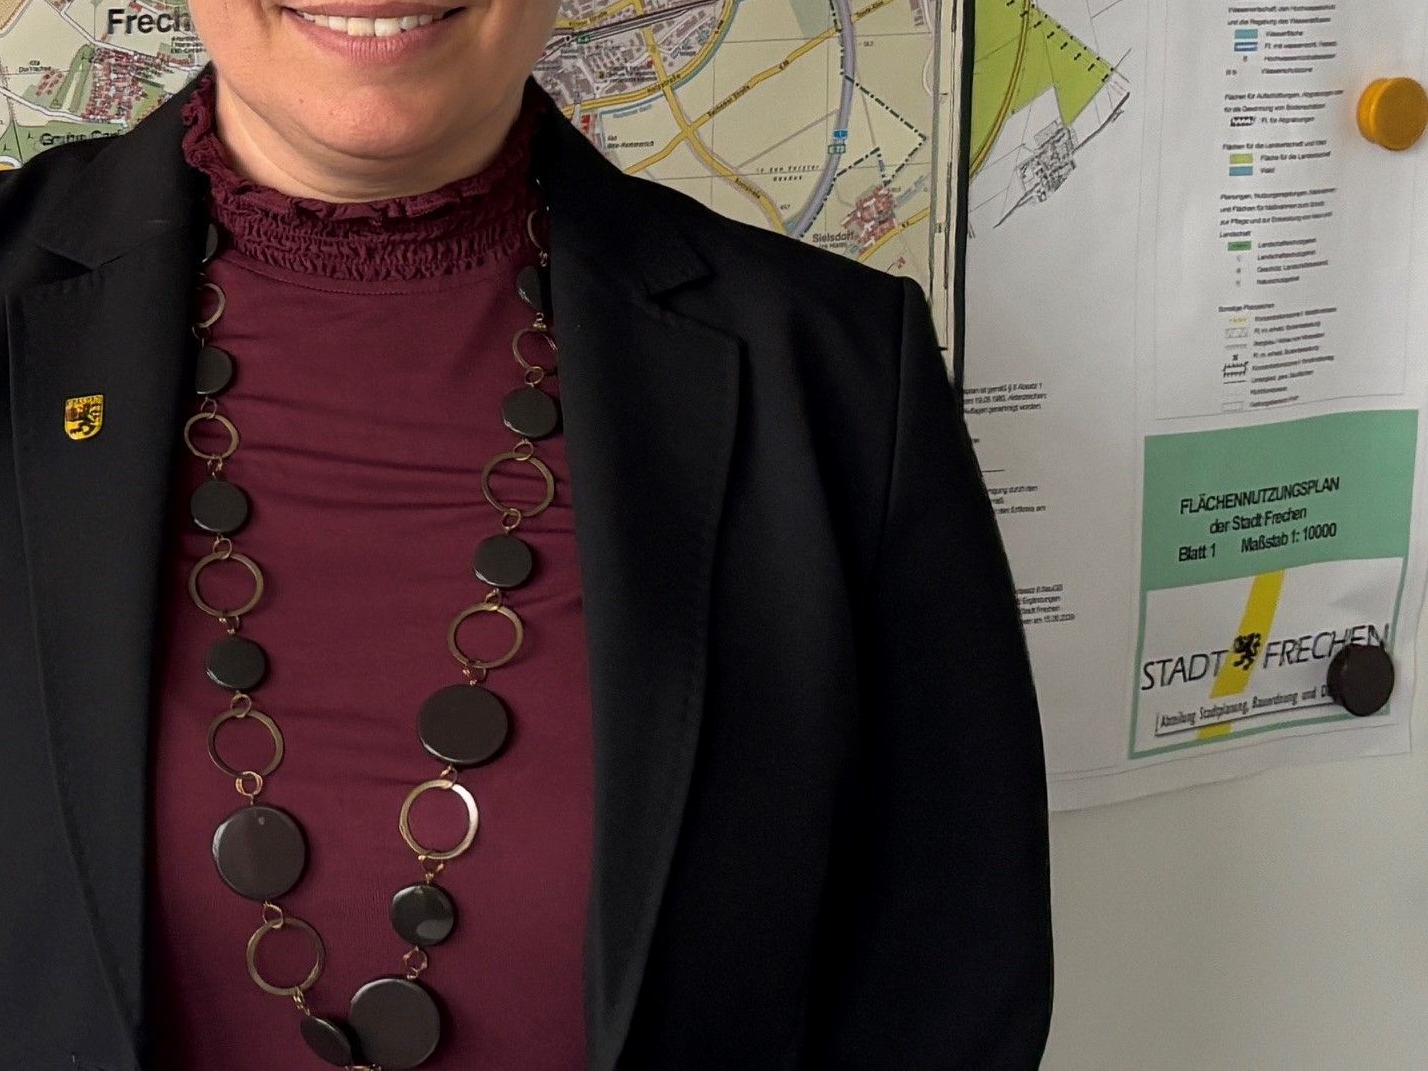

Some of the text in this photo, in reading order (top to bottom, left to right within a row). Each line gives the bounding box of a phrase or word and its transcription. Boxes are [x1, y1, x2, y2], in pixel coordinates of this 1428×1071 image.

[107, 7, 192, 35] Frech
[1181, 477, 1339, 514] FLÄCHENNUTZUNGSPLAN
[1209, 506, 1307, 534] der Stadt Frechen
[1241, 534, 1288, 552] Maßstab
[1303, 522, 1336, 539] 10000
[1178, 547, 1206, 562] Blatt
[1142, 650, 1228, 690] STADT
